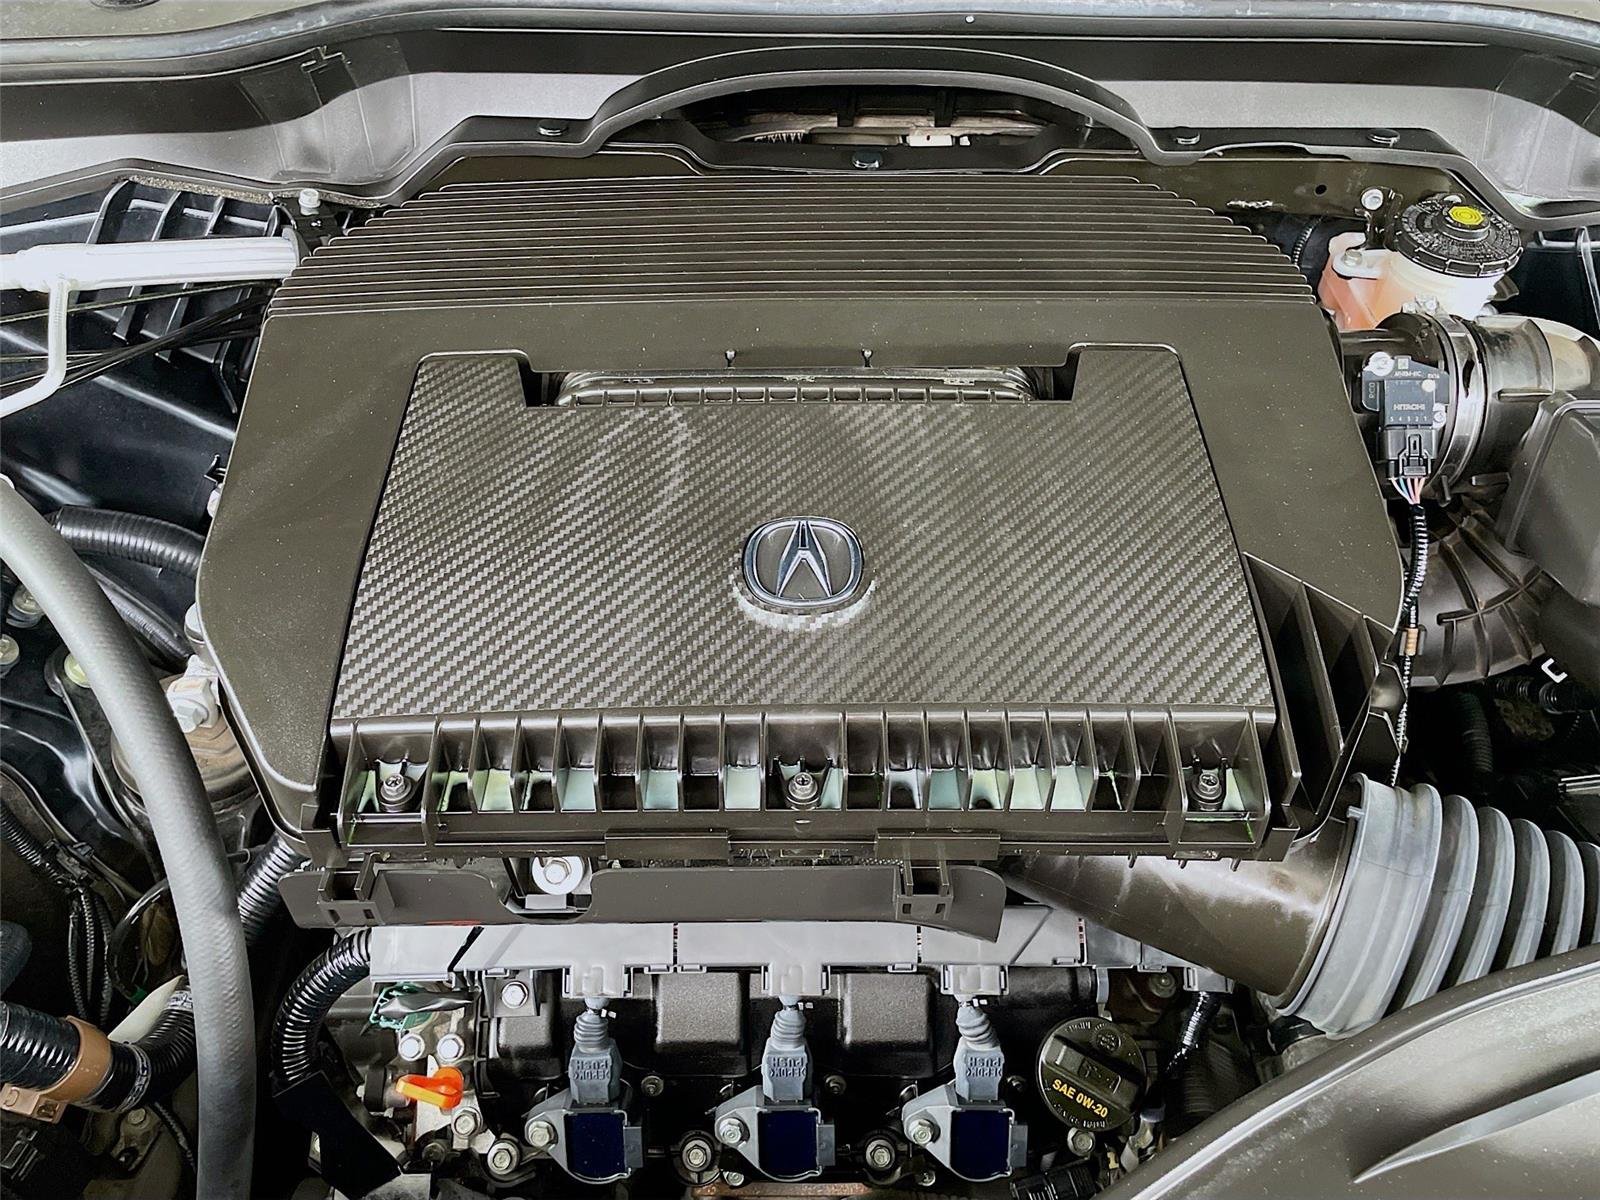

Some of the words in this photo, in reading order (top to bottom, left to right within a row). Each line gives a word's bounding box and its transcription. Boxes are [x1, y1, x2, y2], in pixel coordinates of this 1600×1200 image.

[1393, 403, 1426, 411] HITACHI
[576, 1060, 609, 1070] PUSH
[772, 1057, 804, 1067] PUSH
[968, 1056, 1001, 1067] PUSH
[1052, 1079, 1077, 1099] SAE
[1075, 1092, 1108, 1118] 0W-20
